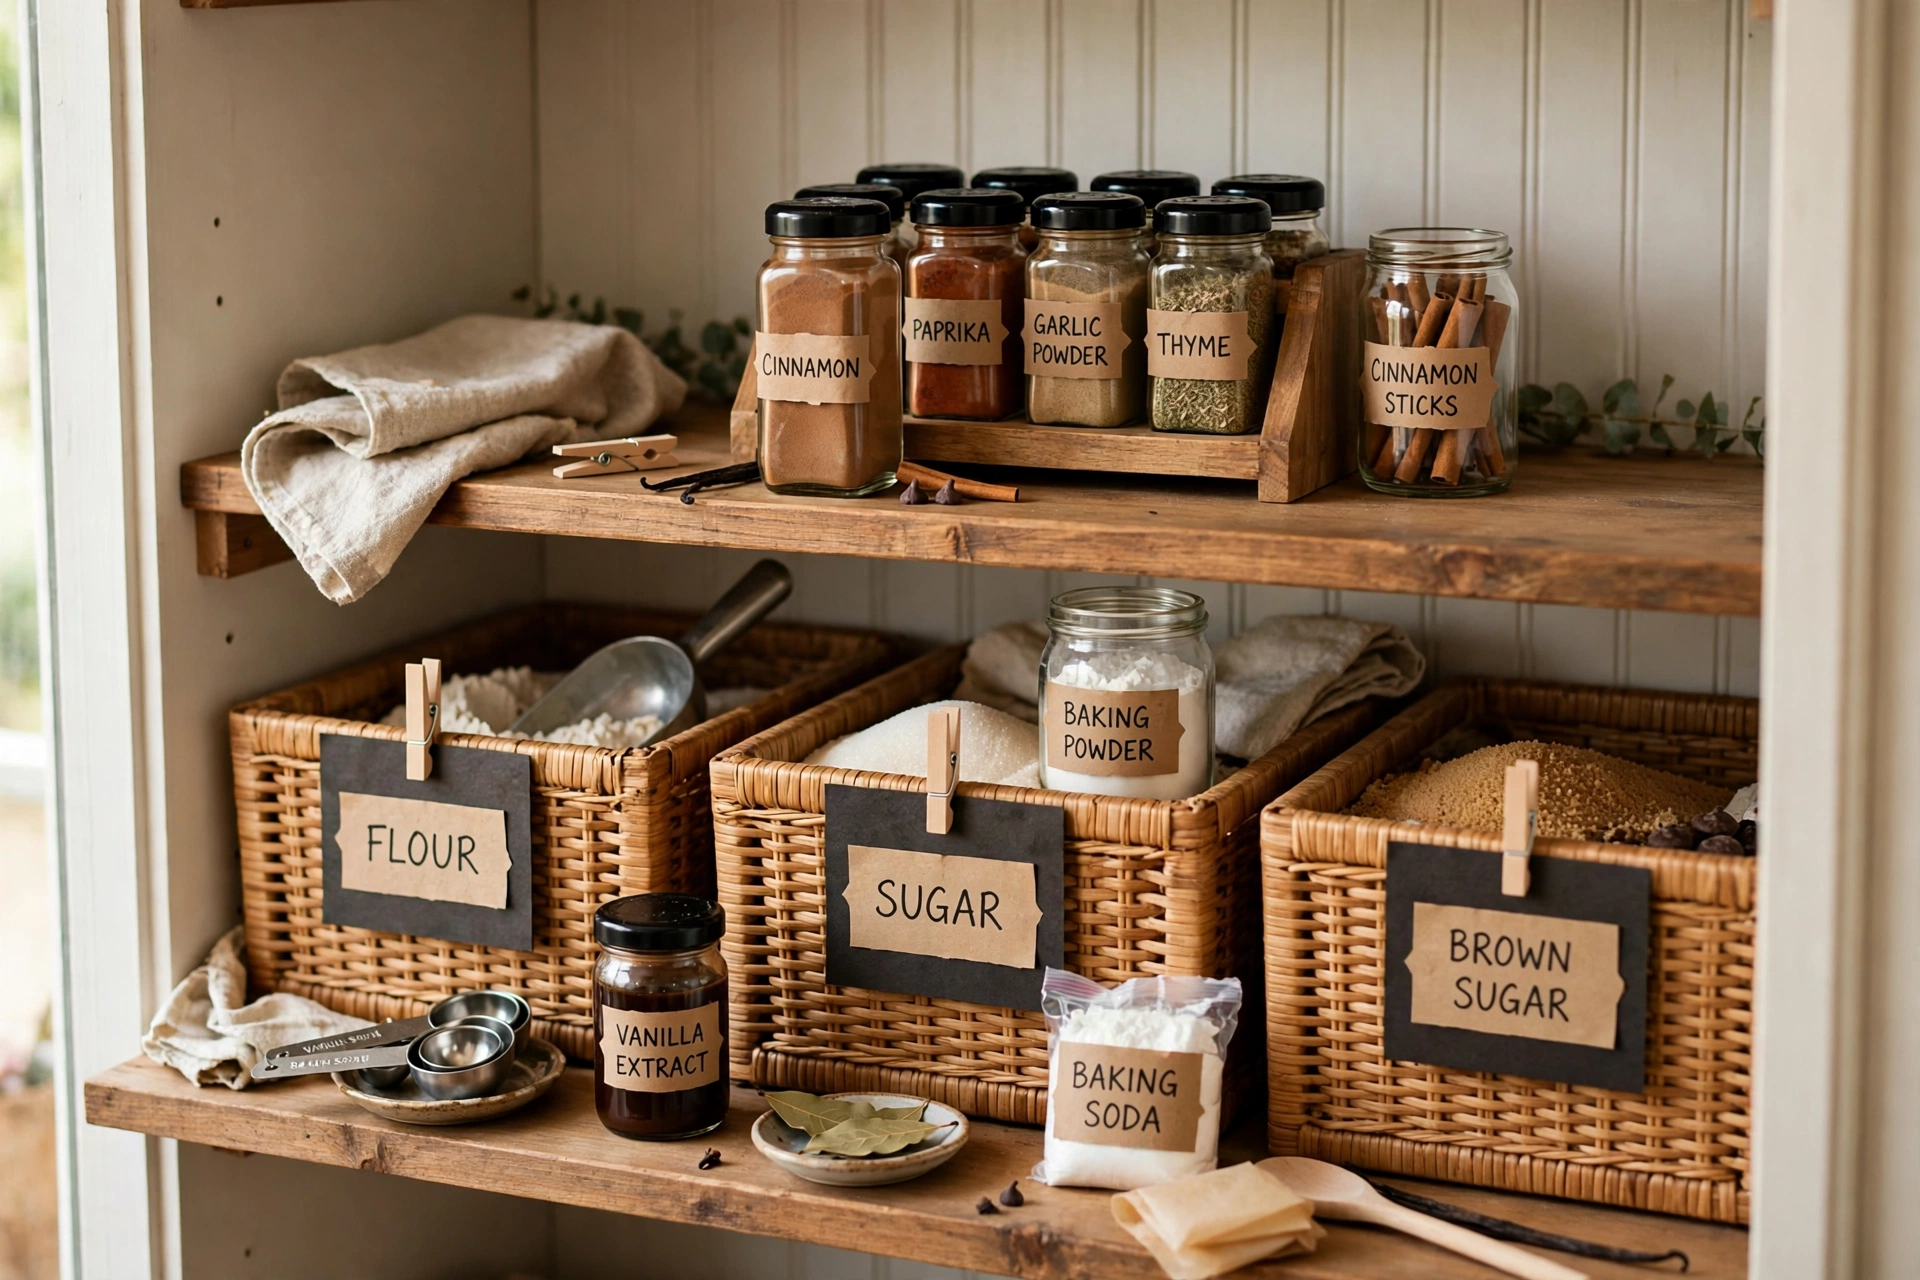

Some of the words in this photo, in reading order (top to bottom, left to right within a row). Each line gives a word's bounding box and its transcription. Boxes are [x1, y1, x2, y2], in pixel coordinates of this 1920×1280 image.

[912, 318, 990, 343] PAPRIKA
[1034, 313, 1102, 337] GARLIC
[1033, 342, 1109, 367] POWDER
[1157, 332, 1231, 358] THYME
[762, 353, 860, 379] CINNAMON
[1371, 358, 1478, 385] CINNAMON
[1385, 391, 1458, 416] STICKS
[1064, 701, 1149, 729] BAKING
[1064, 734, 1154, 761] POWDER
[367, 824, 479, 875] FLOUR
[875, 879, 1003, 931] SUGAR
[1450, 928, 1571, 973] BROWN
[1454, 976, 1569, 1022] SUGAR
[616, 1022, 704, 1047] VANILLA
[616, 1050, 709, 1078] EXTRACT
[1072, 1061, 1178, 1098] BAKING
[1084, 1100, 1161, 1133] SODA
